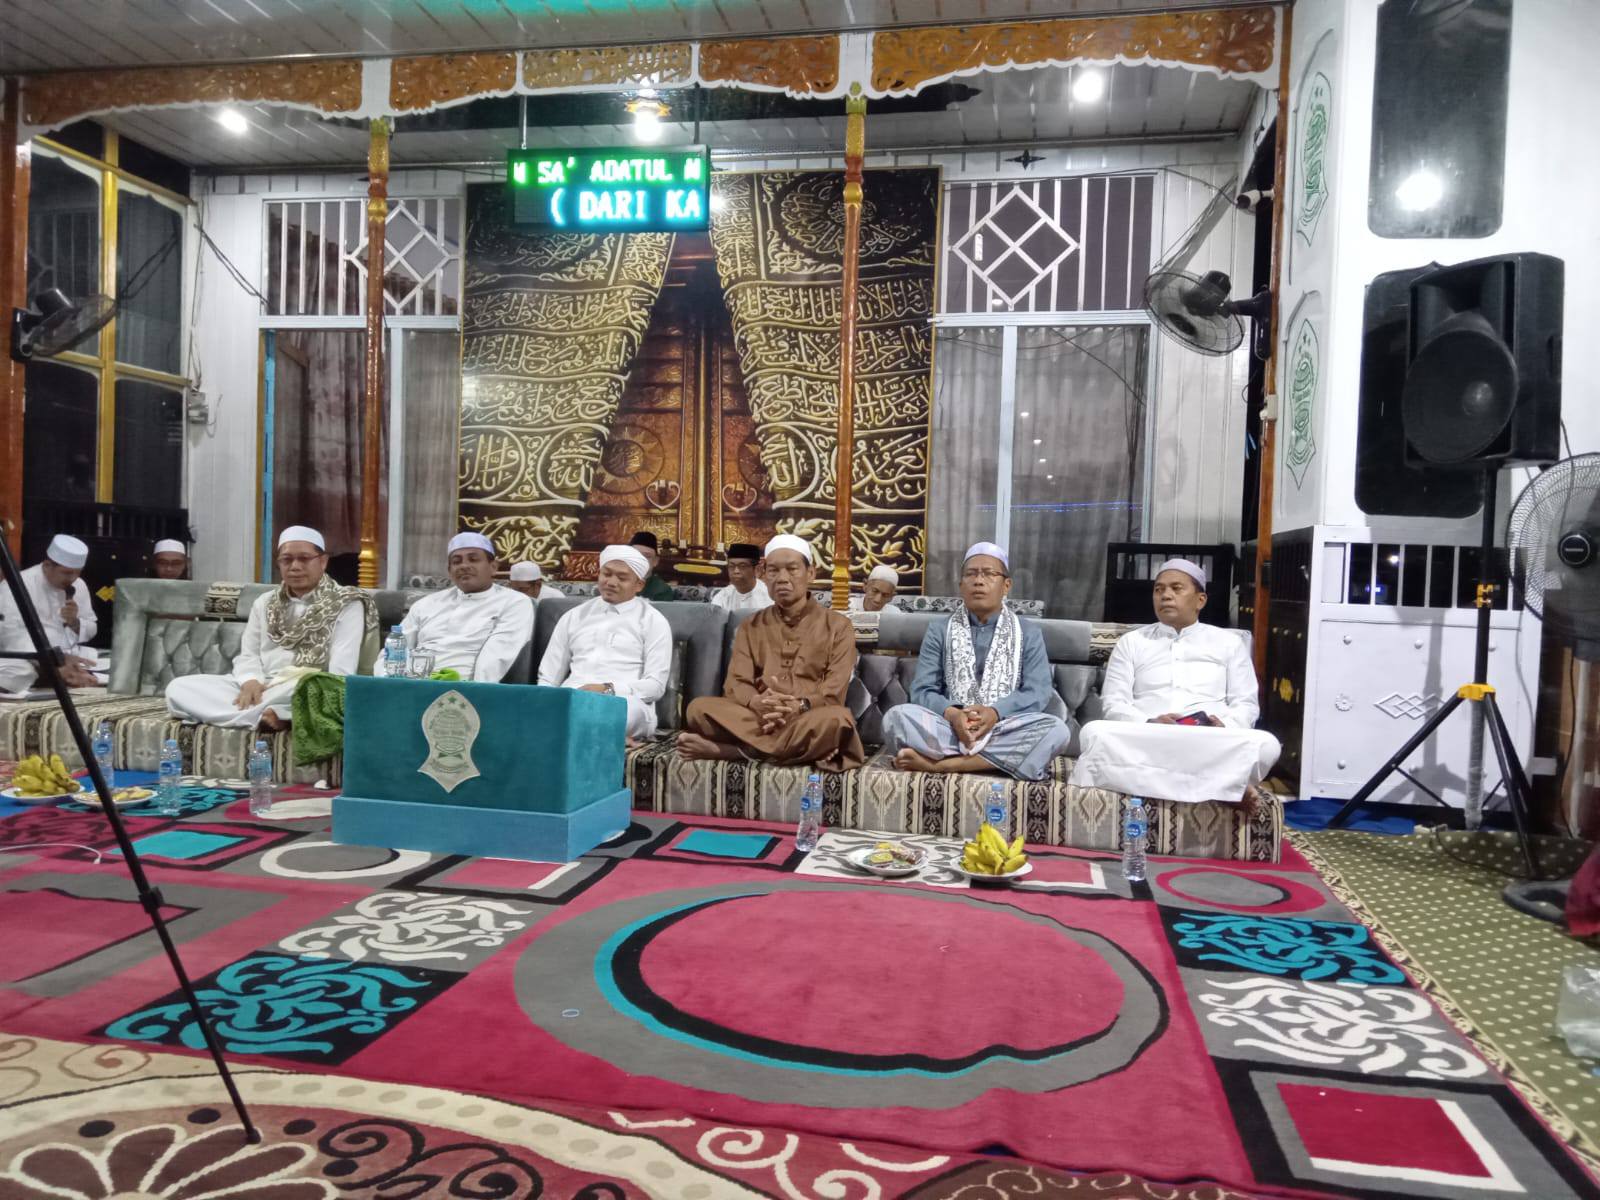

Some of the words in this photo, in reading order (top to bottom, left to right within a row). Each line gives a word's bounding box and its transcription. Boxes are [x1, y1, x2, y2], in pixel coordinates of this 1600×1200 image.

[590, 159, 673, 181] ADATUL
[579, 190, 646, 220] DARI
[666, 189, 701, 218] KA
